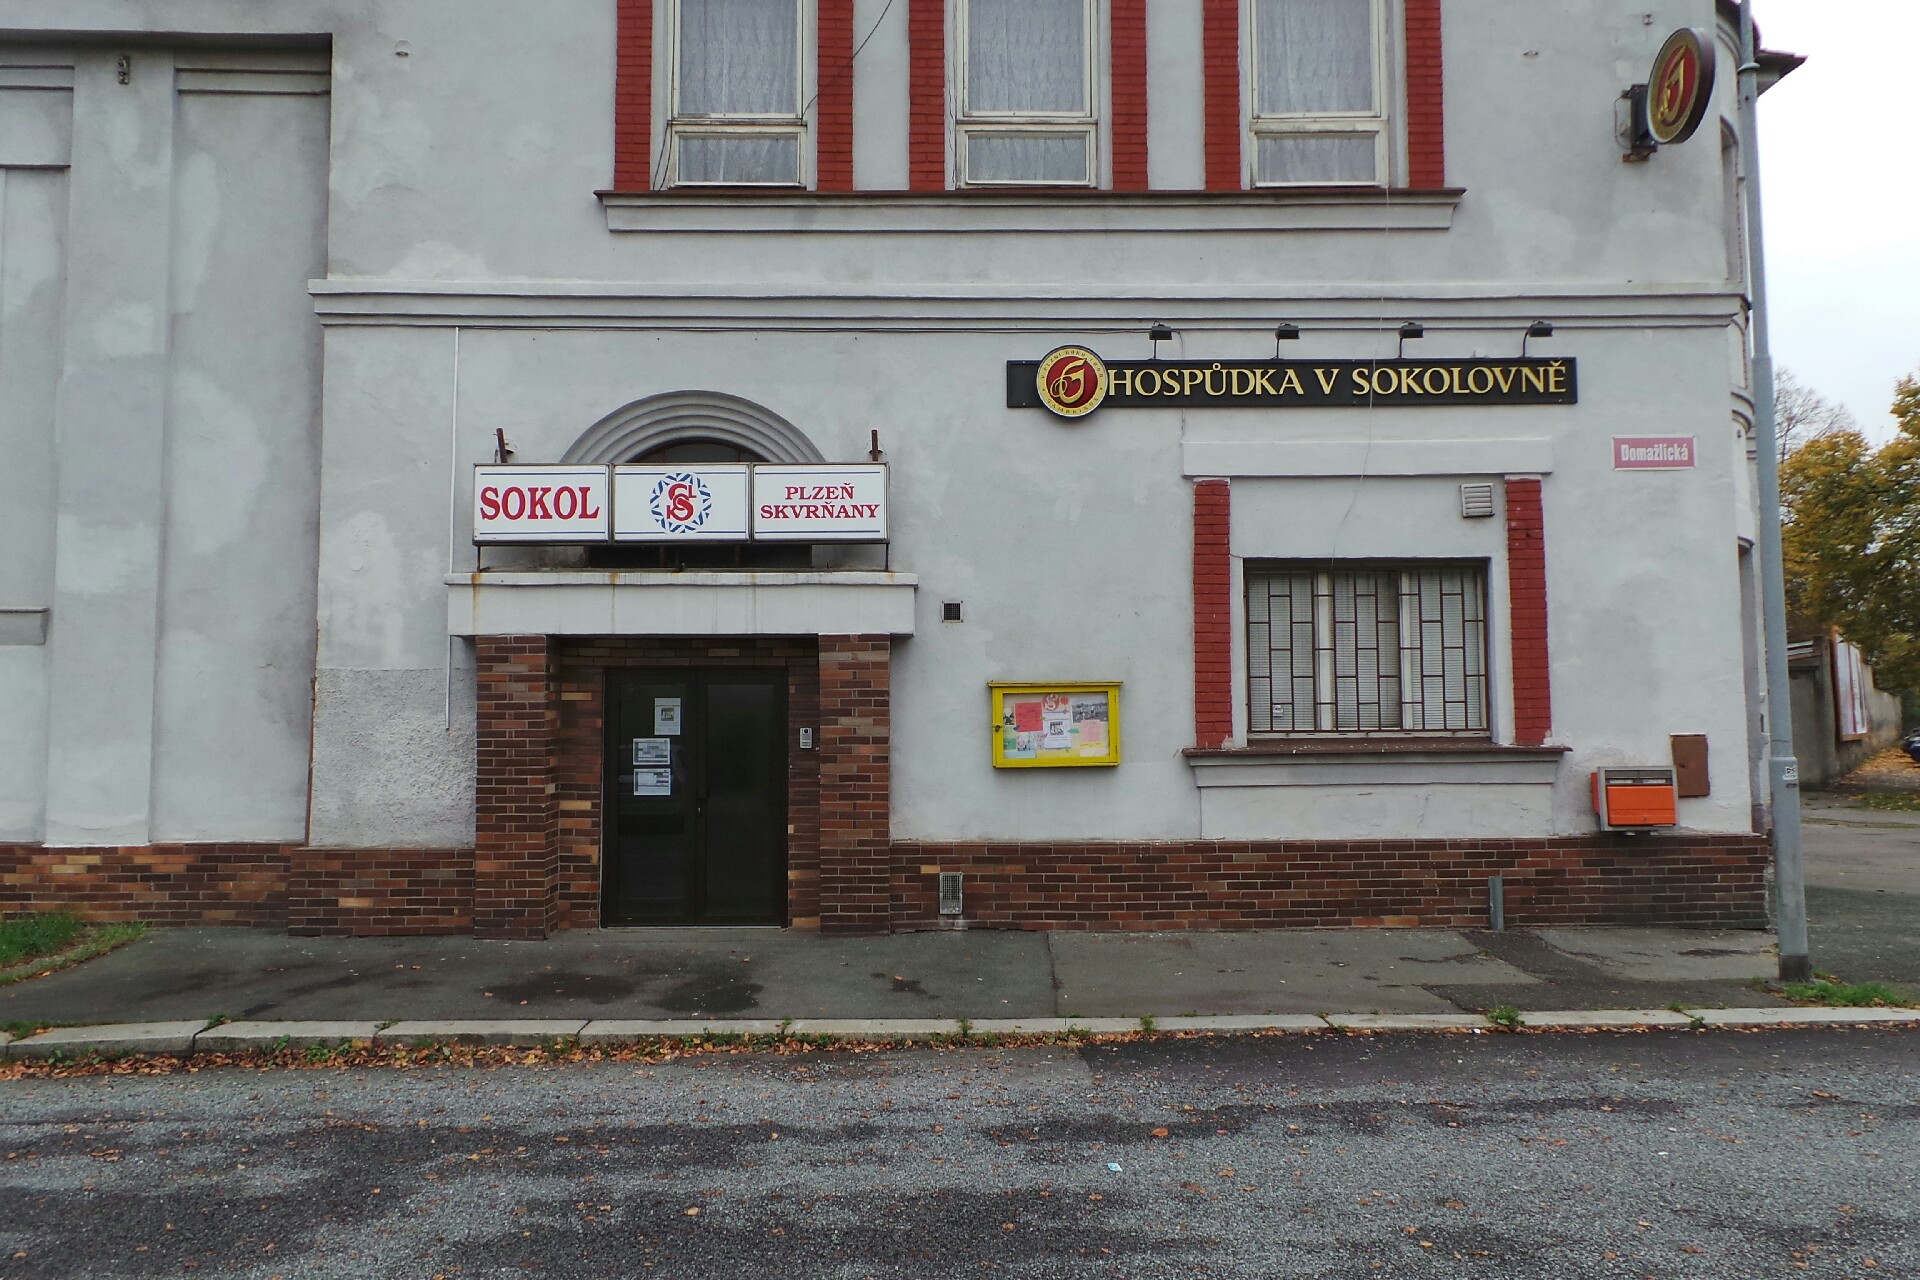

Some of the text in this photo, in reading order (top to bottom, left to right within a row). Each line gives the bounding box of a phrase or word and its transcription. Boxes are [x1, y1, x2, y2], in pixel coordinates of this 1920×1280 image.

[1107, 360, 1566, 396] HOSPŮDKA V SOKOLOVNĚ
[1620, 443, 1689, 461] Domažlická
[785, 482, 854, 500] PLZEŇ
[480, 486, 600, 520] SOKOL
[760, 501, 881, 519] SKVRŇANY
